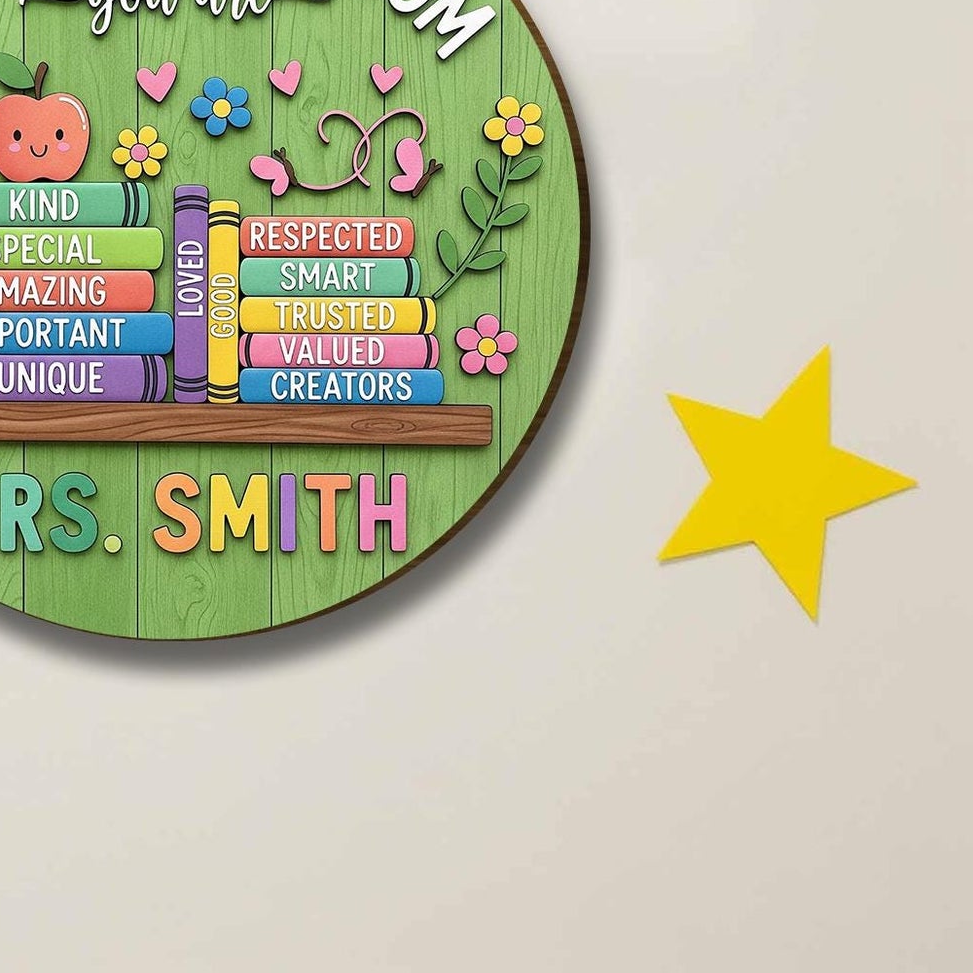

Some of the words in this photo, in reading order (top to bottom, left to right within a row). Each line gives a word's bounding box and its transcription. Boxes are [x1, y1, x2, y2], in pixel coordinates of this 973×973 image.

[9, 188, 78, 221] KIND
[250, 222, 403, 251] RESPECTED
[177, 240, 204, 317] LOVED
[280, 262, 376, 291] SMART
[210, 273, 236, 338] GOOD
[274, 301, 396, 330] TRUSTED
[278, 336, 385, 365] VALUED
[270, 372, 412, 401] CREATORS
[153, 473, 408, 553] SMITH
